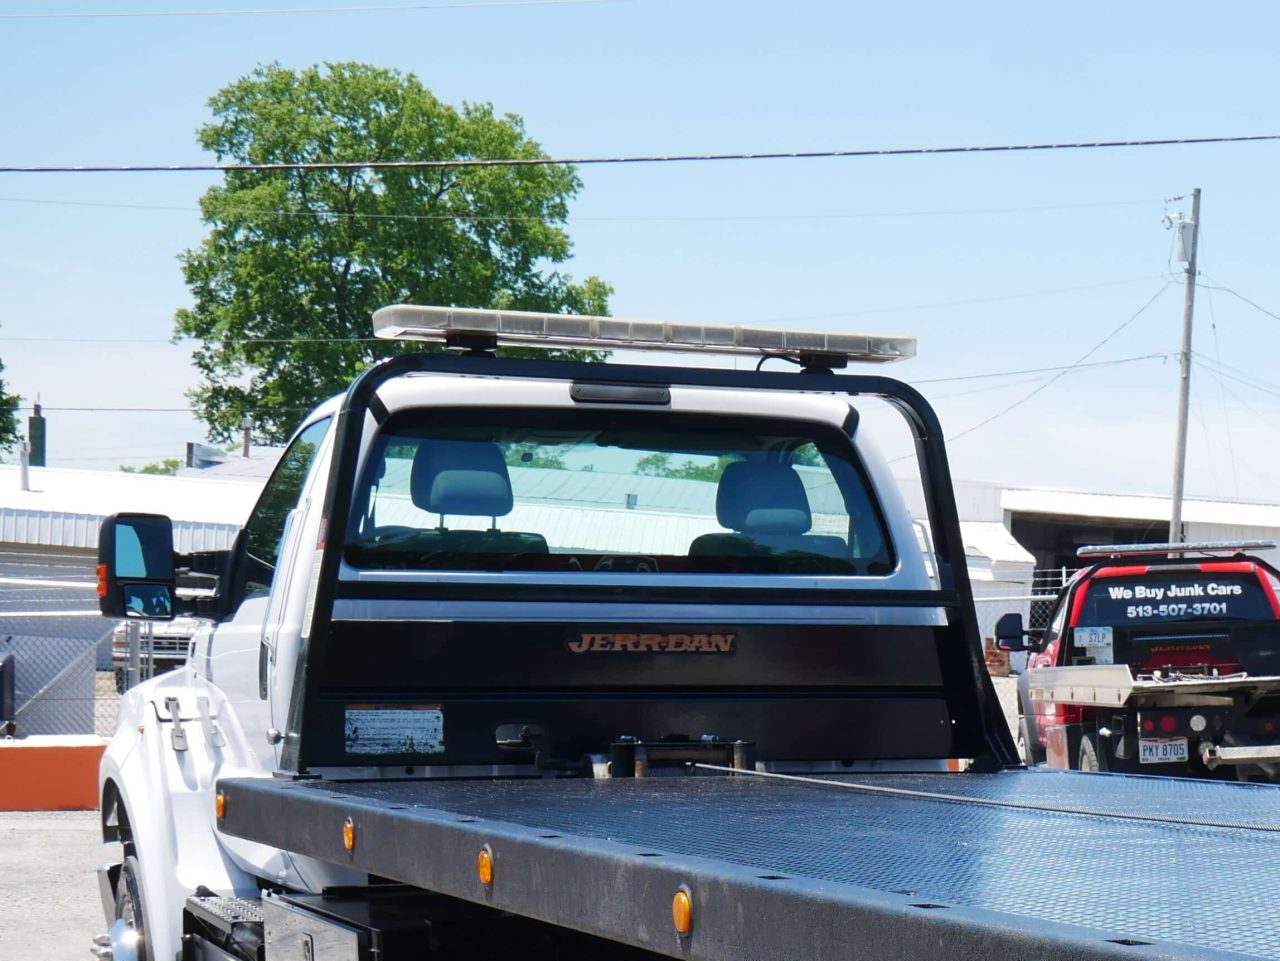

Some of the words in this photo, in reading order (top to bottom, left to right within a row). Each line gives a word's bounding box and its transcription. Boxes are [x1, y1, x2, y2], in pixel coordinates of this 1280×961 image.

[1108, 586, 1132, 600] We
[1135, 585, 1164, 600] Buy
[1167, 583, 1204, 597] Junk
[1207, 582, 1243, 596] Cars
[1126, 603, 1227, 618] 513-507-3701
[567, 633, 737, 653] JERR-DAN
[1142, 744, 1159, 757] PKY
[1162, 743, 1185, 756] 8705
